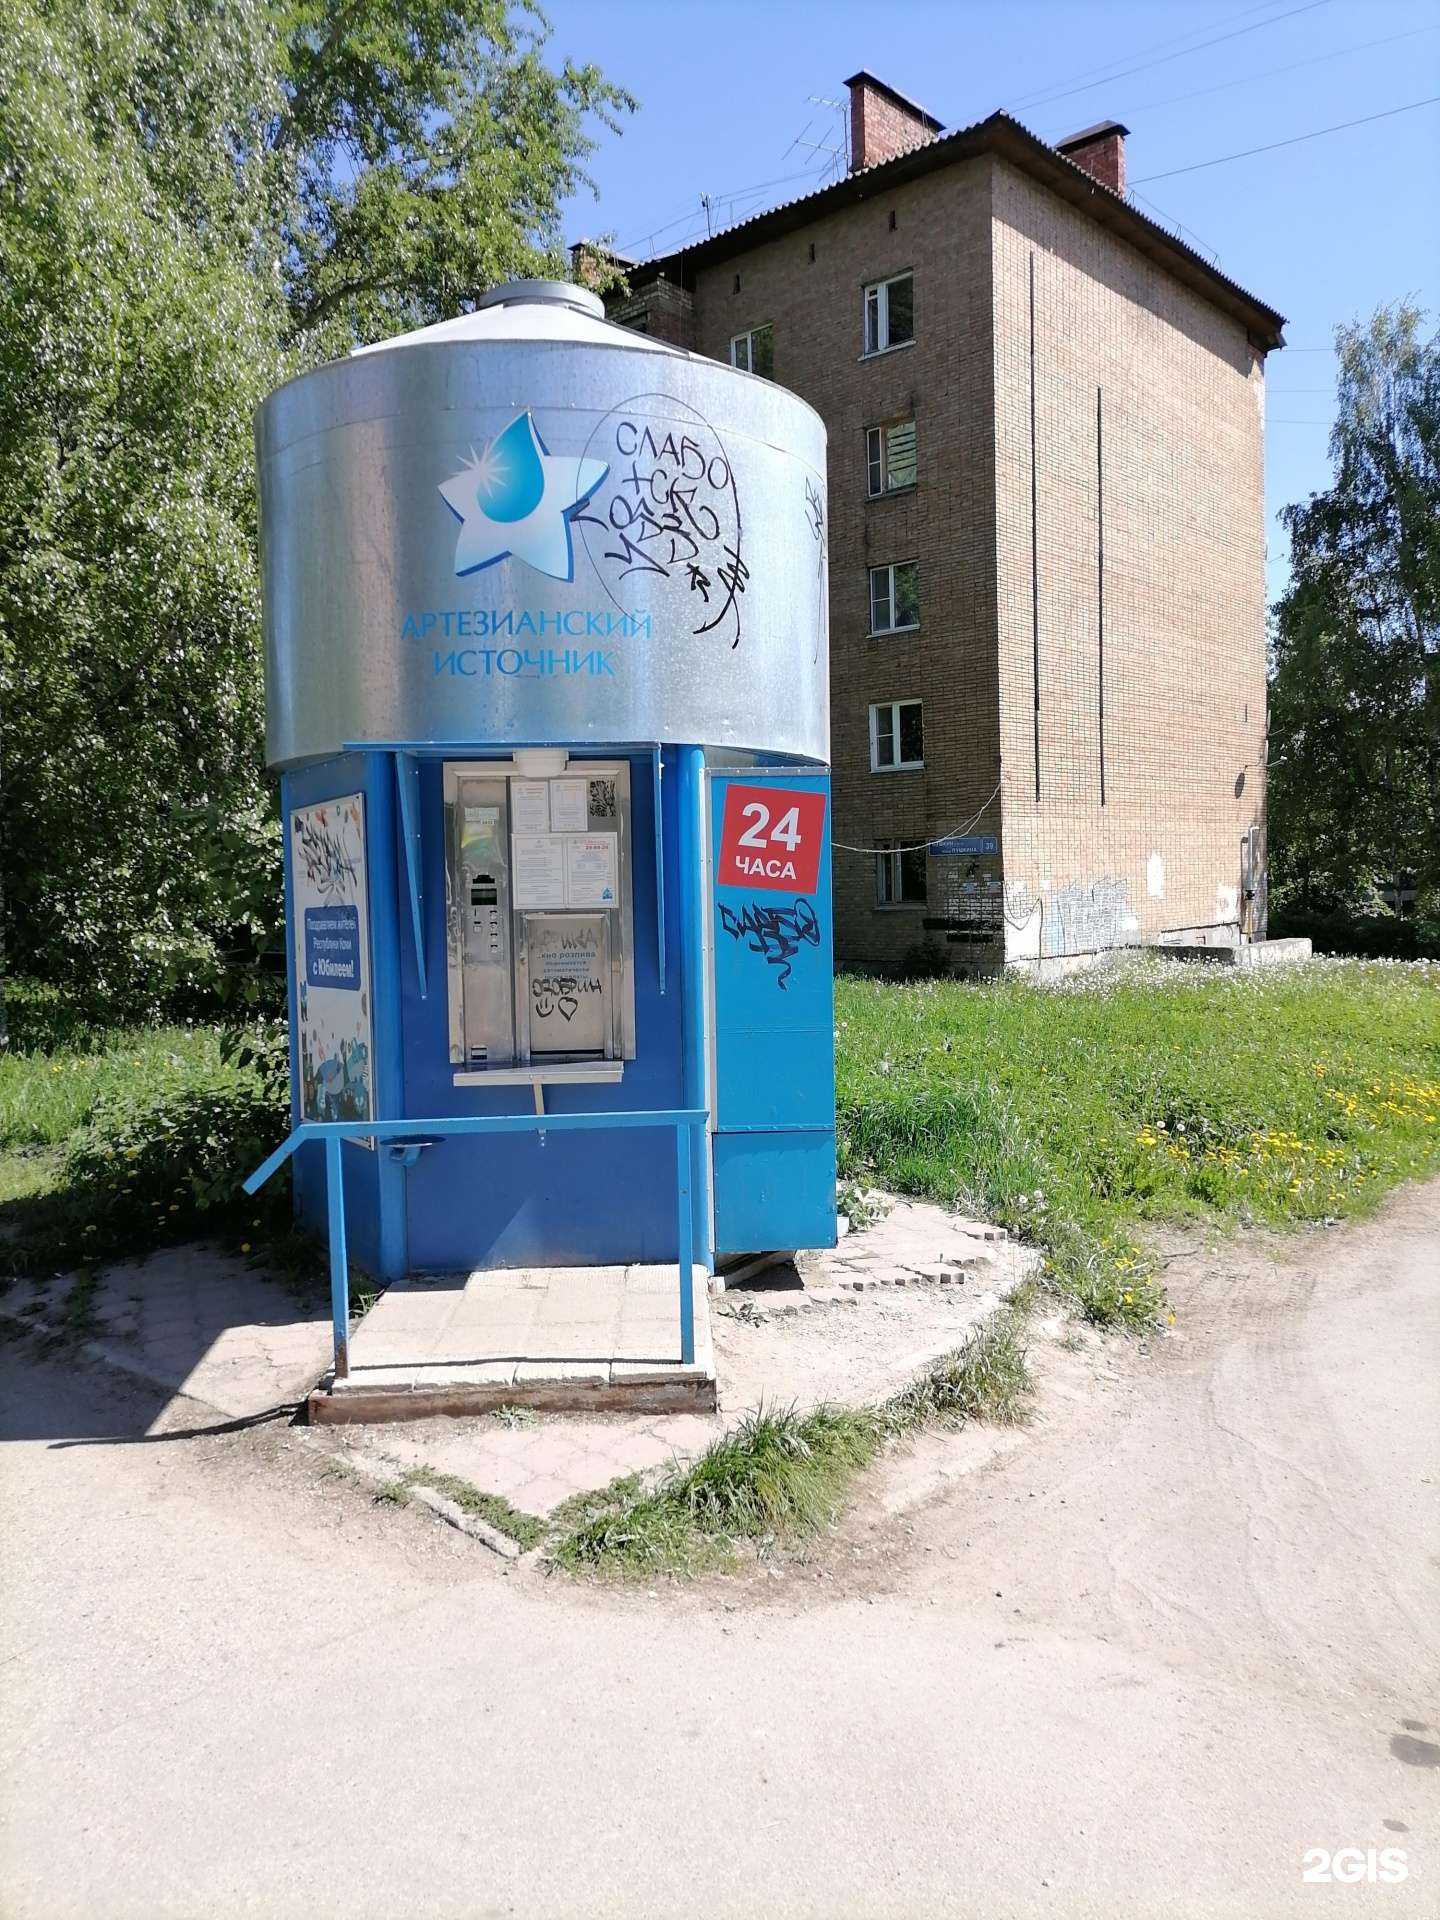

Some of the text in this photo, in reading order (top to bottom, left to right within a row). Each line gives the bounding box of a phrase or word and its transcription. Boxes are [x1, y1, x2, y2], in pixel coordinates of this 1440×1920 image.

[401, 608, 650, 640] АРТЕЗИАНСКИЙ
[432, 649, 617, 677] ИСТОЧНИК
[738, 803, 802, 852] 24
[735, 856, 797, 880] ЧАСА
